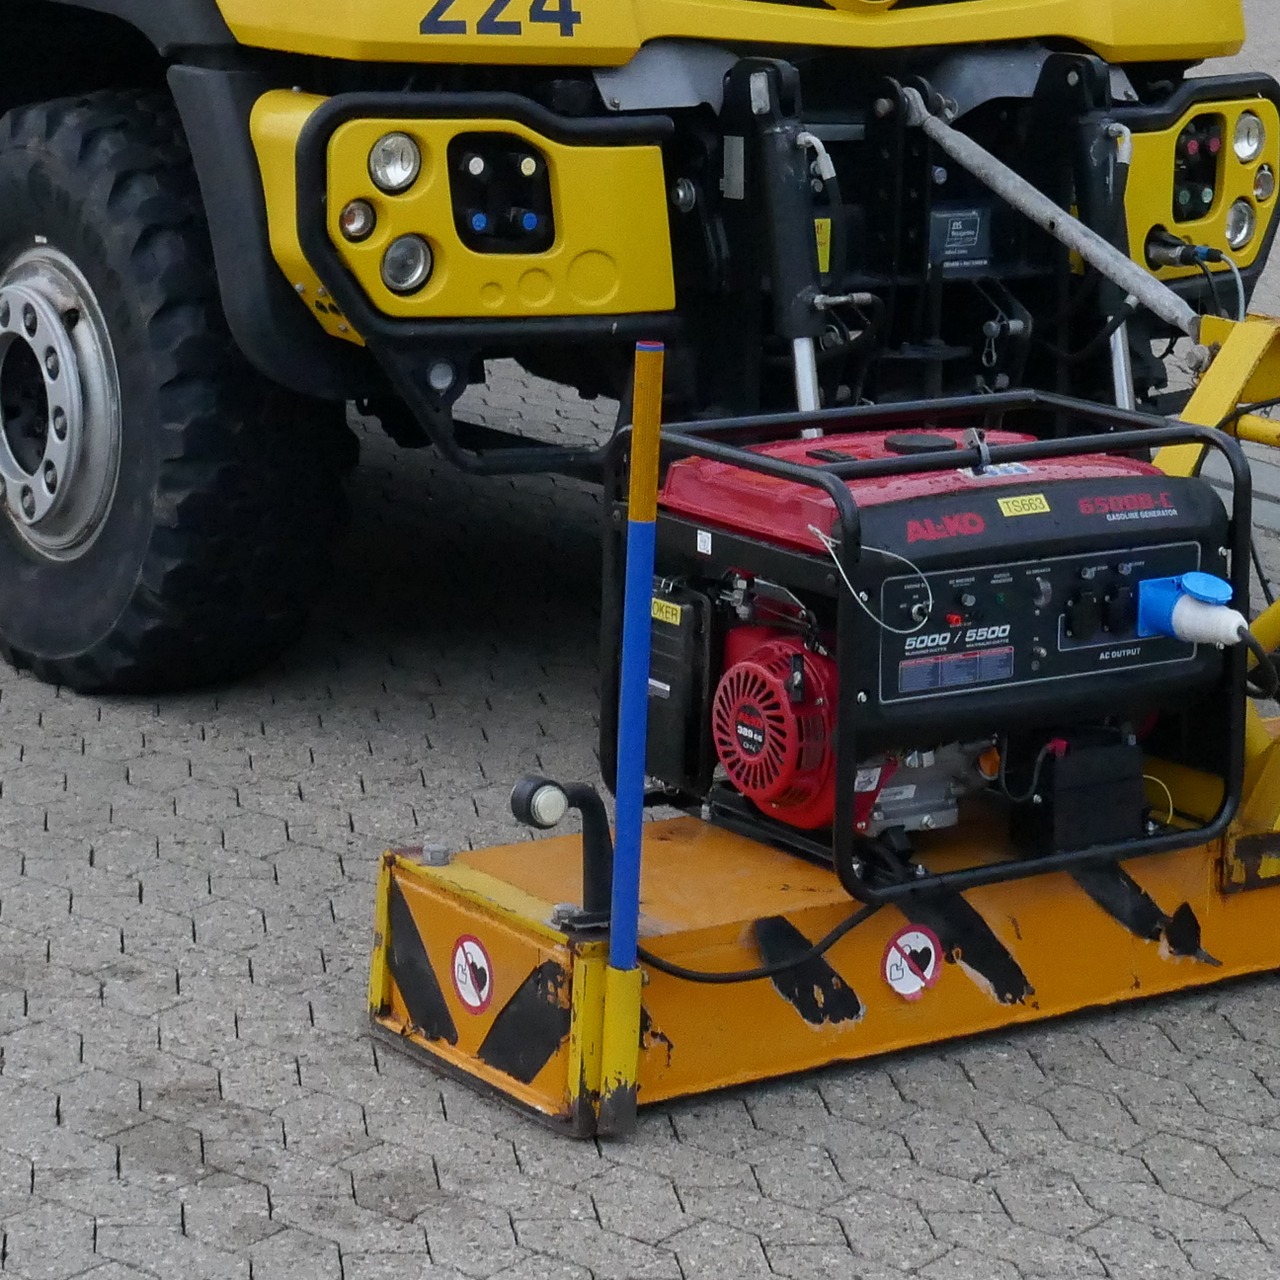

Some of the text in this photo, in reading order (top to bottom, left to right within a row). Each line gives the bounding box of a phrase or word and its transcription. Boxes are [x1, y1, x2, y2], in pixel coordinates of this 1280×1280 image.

[1003, 497, 1047, 514] TS663
[904, 632, 951, 650] 5000
[965, 624, 1011, 642] 5500
[1099, 647, 1141, 660] AC OUTPUT
